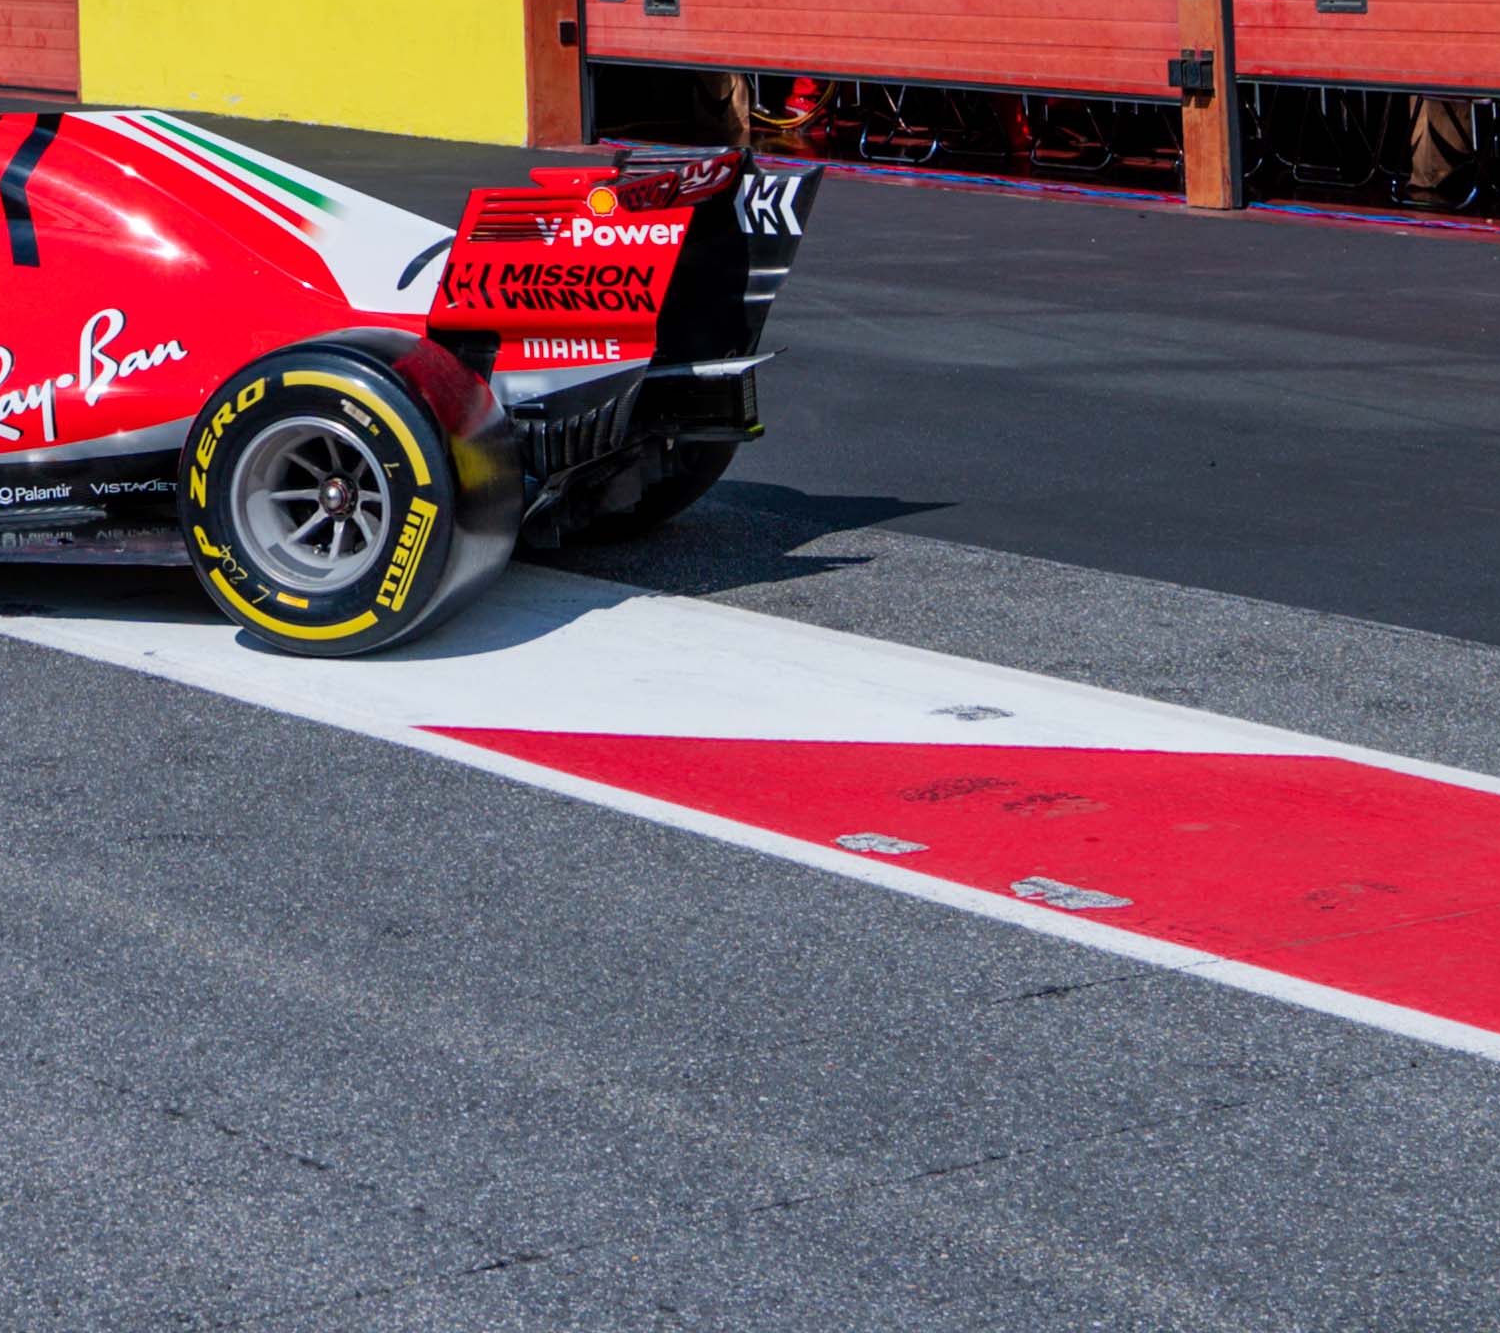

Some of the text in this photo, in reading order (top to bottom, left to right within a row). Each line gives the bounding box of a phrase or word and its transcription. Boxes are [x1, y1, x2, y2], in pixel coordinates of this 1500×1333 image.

[535, 217, 685, 247] V-Power
[500, 264, 655, 288] MISSION
[500, 288, 657, 312] WINNOW
[523, 337, 621, 361] MAHLE
[190, 377, 266, 558] P ZERO
[15, 483, 73, 502] Palantir
[376, 496, 439, 612] PIRELLI
